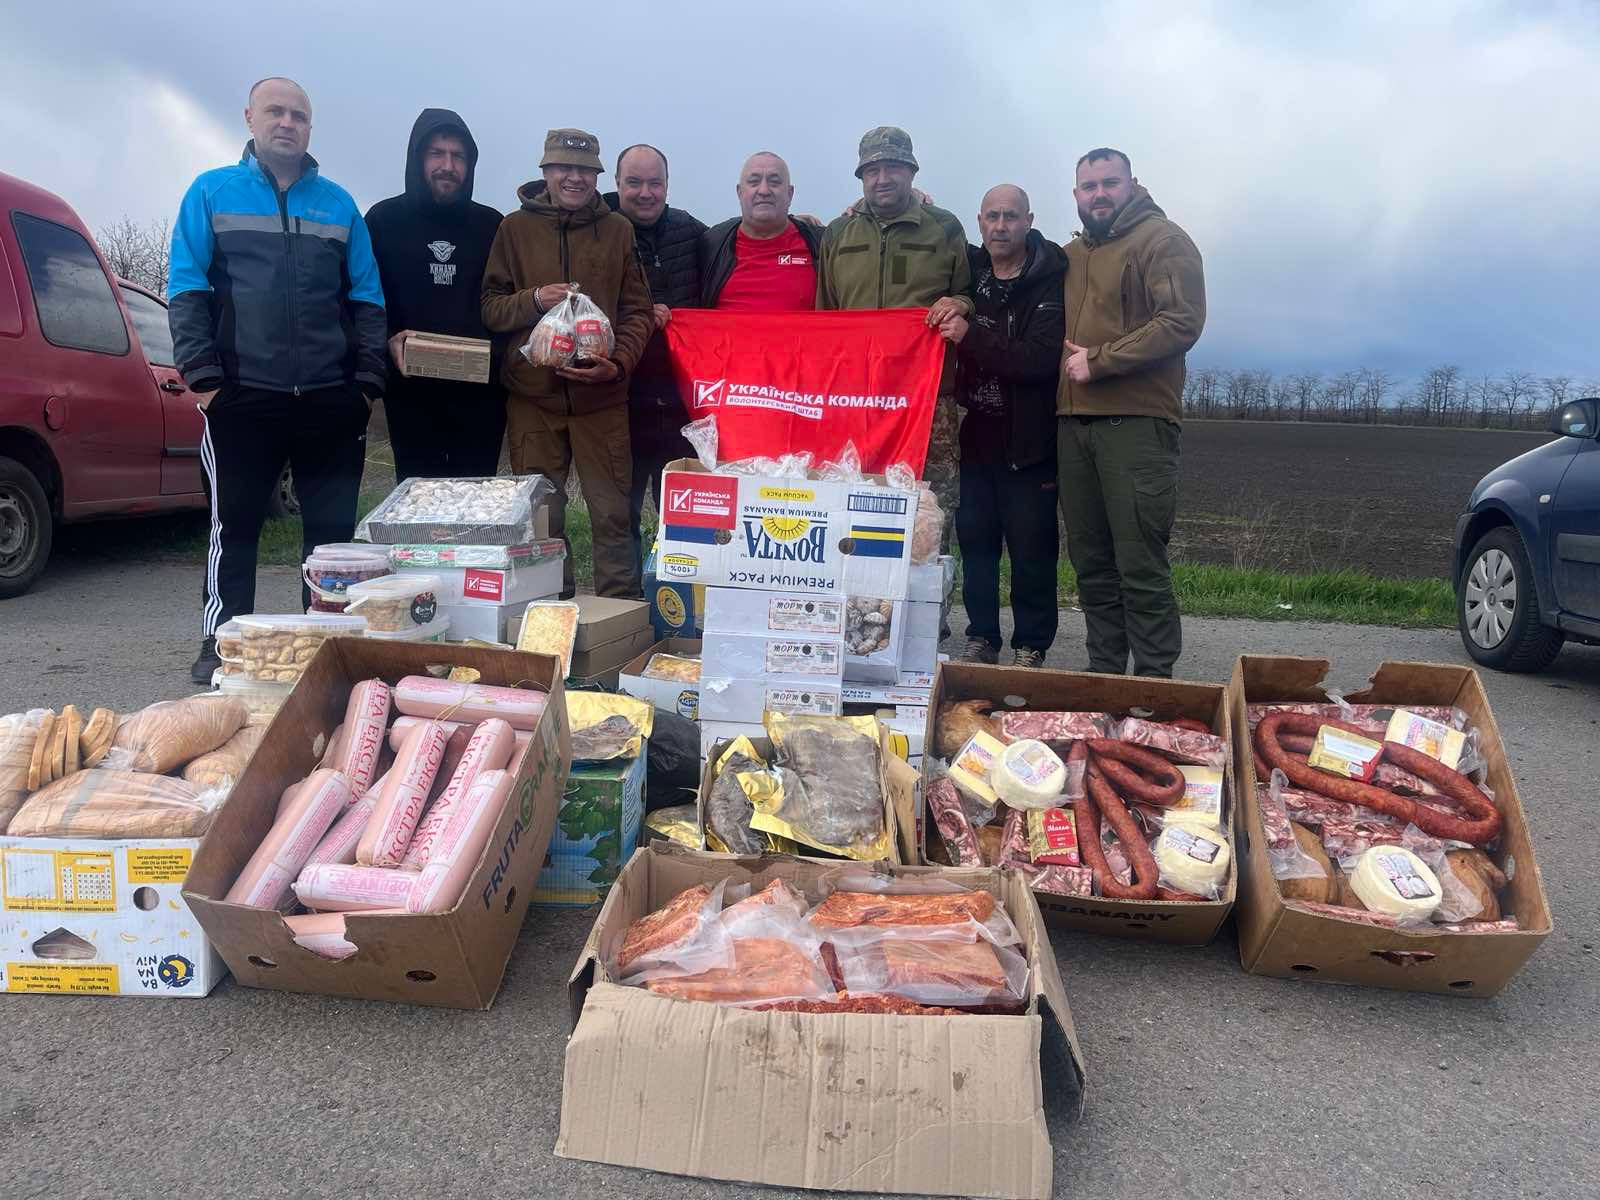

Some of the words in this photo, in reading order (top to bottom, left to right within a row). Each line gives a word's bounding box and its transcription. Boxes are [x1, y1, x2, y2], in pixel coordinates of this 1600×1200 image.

[728, 383, 824, 406] УКРАЇНСЬКА
[828, 394, 908, 411] КОМАНДА
[796, 406, 819, 418] ШТАБ
[694, 491, 731, 499] УКРАЇНСЬКА
[743, 505, 785, 515] BANANAS
[788, 508, 828, 518] PREMIUM
[743, 520, 828, 564] BONITA
[670, 565, 691, 573] 100%
[729, 571, 765, 584] PACK
[770, 574, 835, 589] PREMIUM
